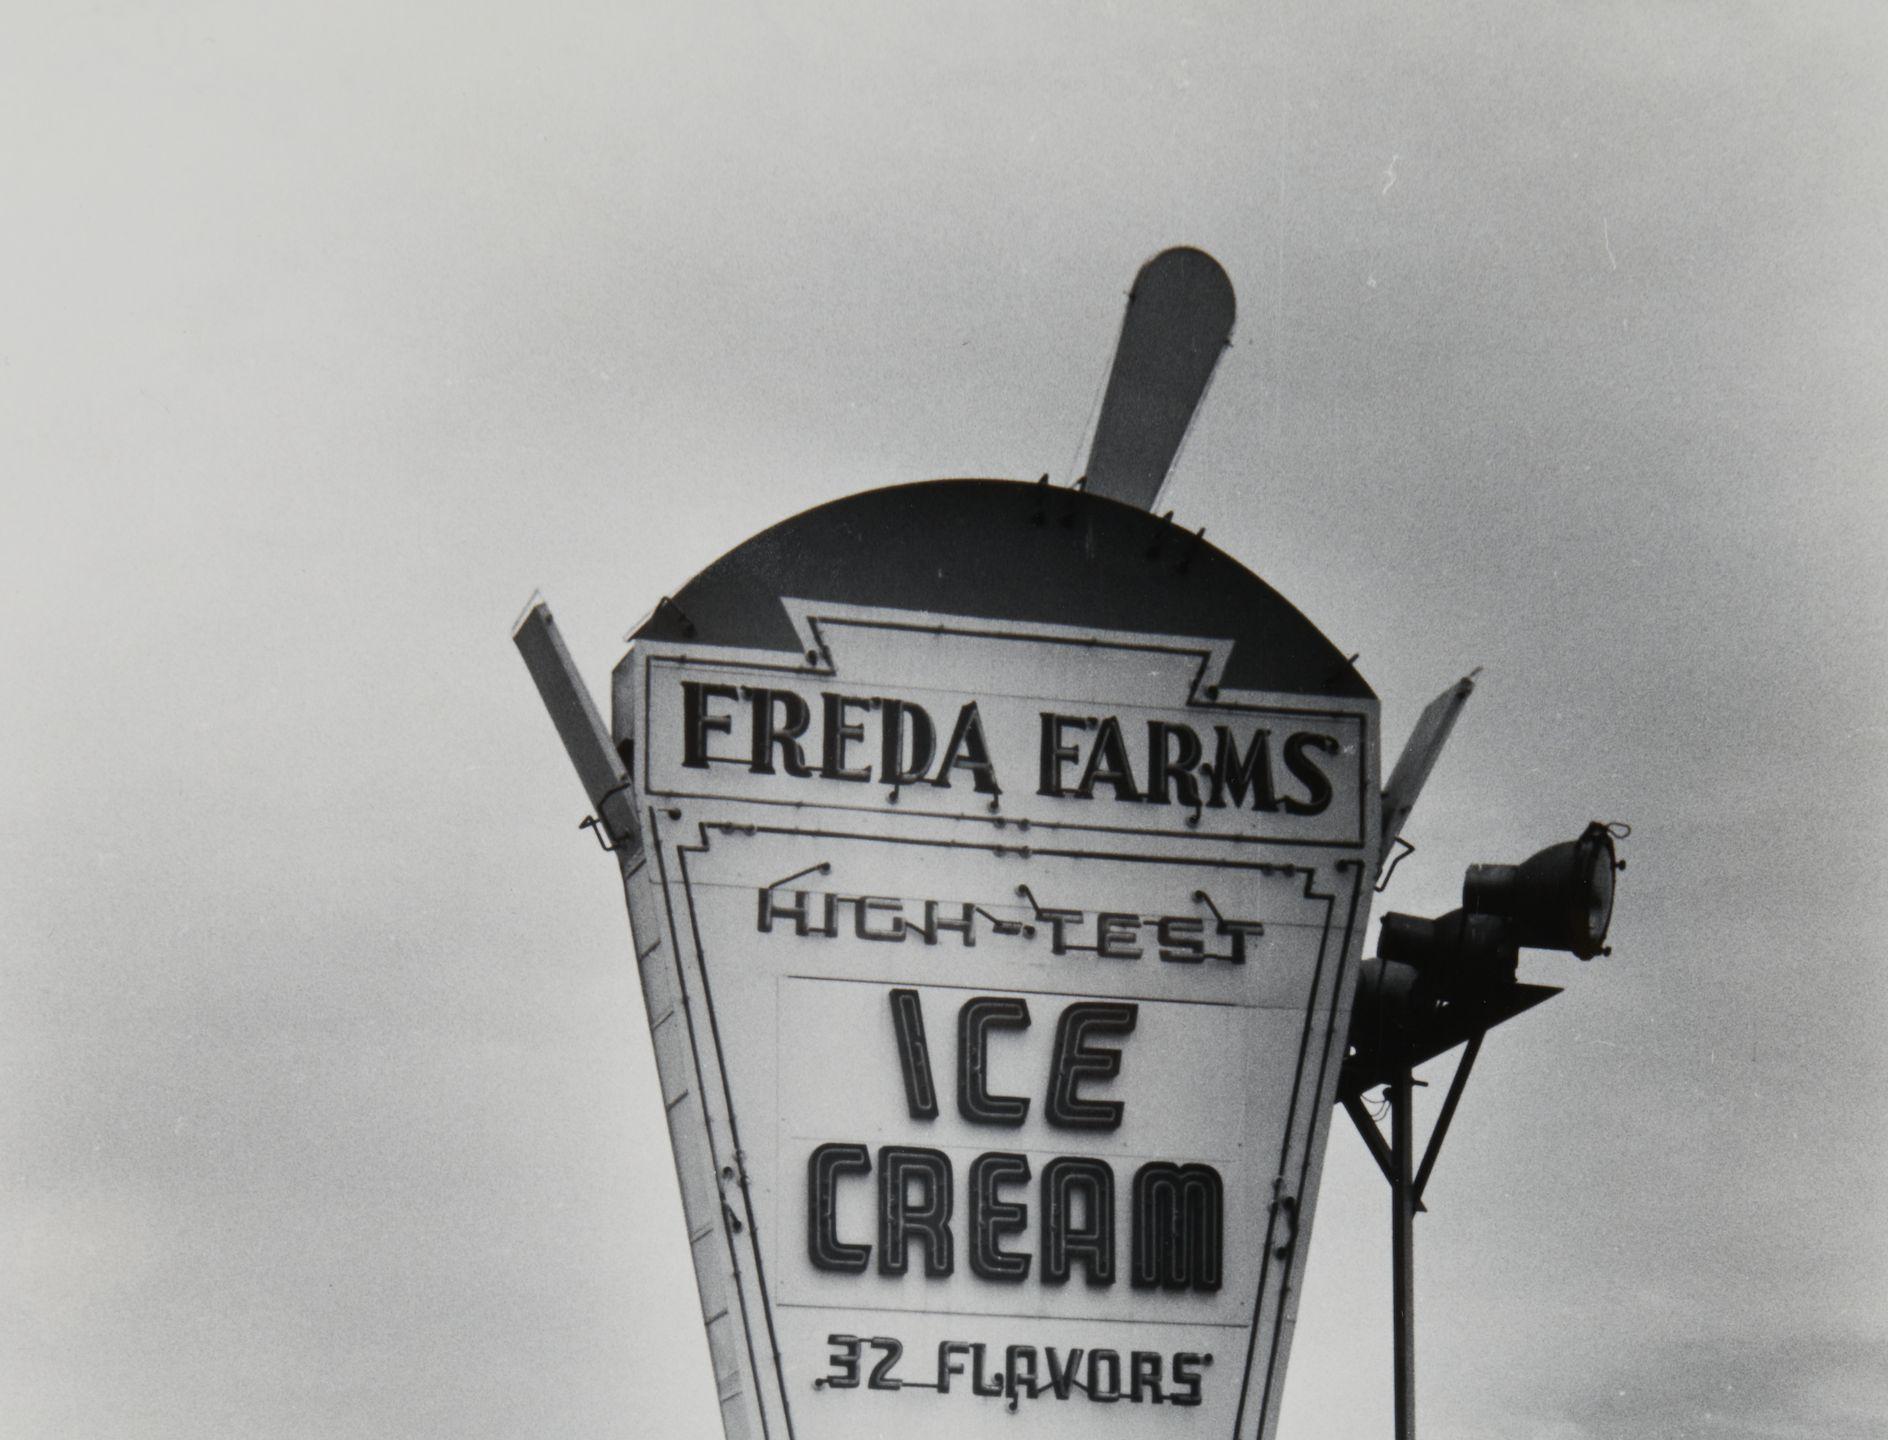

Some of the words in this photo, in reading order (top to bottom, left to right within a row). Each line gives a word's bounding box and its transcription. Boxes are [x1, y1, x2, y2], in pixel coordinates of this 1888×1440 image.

[681, 681, 1001, 796] FREDA
[1037, 711, 1340, 817] FARMS
[758, 886, 1264, 964] HIGH-TEST
[889, 988, 1138, 1130] ICE
[807, 1142, 1223, 1292] CREAM
[826, 1334, 904, 1390] 32
[937, 1340, 1202, 1406] FLAVORS
